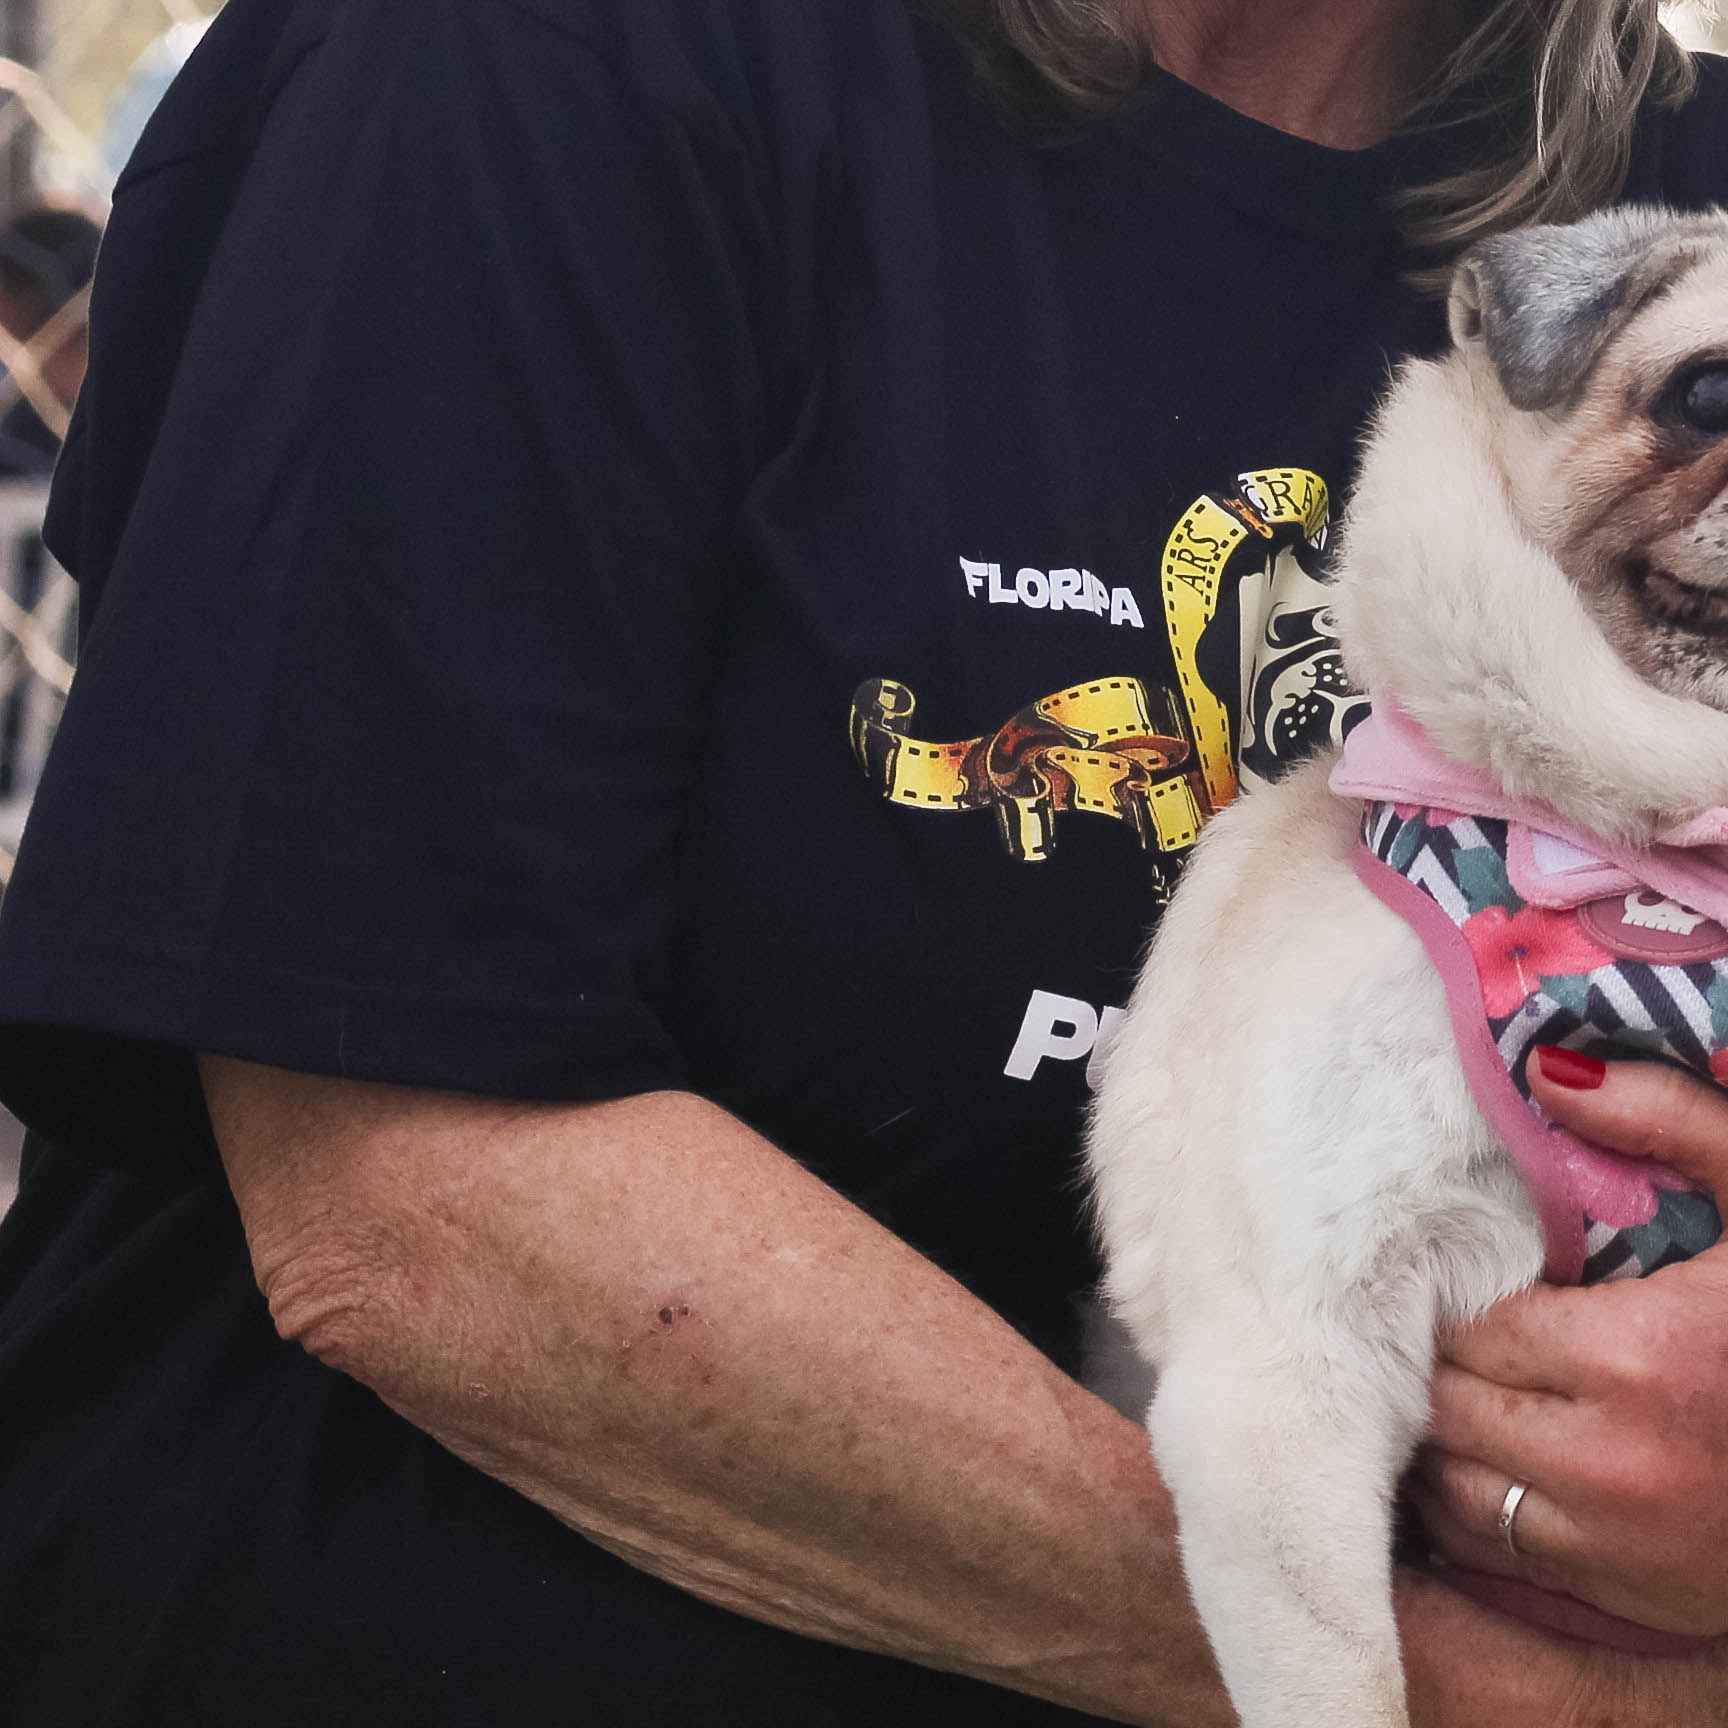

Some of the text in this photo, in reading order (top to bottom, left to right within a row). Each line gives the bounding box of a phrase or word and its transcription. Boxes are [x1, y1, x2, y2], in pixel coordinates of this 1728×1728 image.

[1245, 478, 1327, 518] GRA
[959, 555, 1146, 629] FLORIPA
[1174, 524, 1220, 597] ARS
